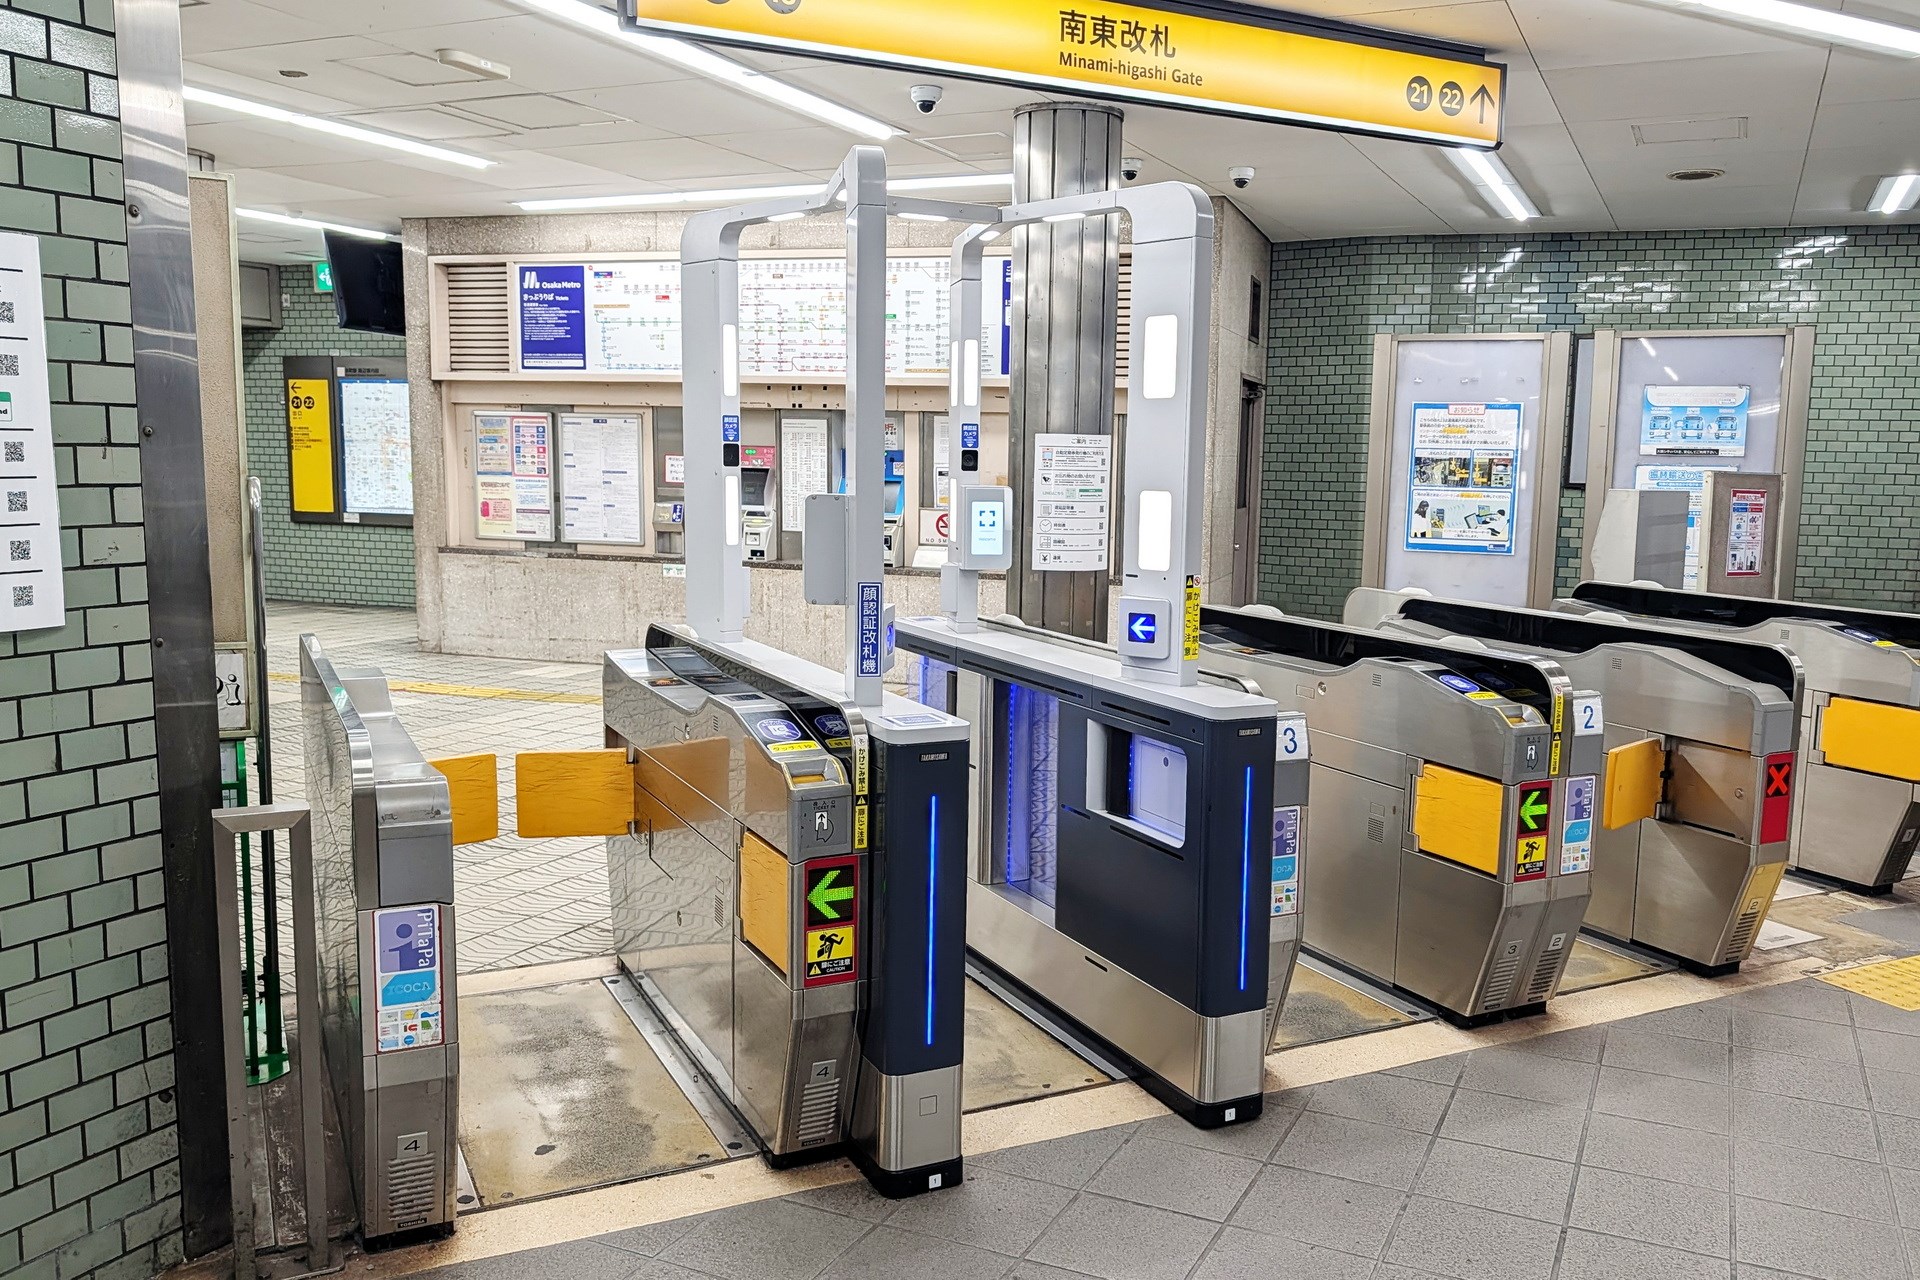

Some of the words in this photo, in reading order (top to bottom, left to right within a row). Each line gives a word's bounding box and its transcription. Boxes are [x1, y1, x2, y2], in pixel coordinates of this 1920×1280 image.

[1059, 10, 1176, 58] 南東改札
[1059, 51, 1167, 81] Minami-higashi
[1171, 68, 1203, 86] Gate
[1410, 82, 1428, 104] 21
[1441, 87, 1461, 109] 22
[541, 281, 561, 289] Osaka
[561, 281, 581, 289] Metro
[293, 398, 301, 407] 21
[304, 398, 314, 407] 22
[1453, 406, 1480, 414] お知らせ
[862, 586, 878, 673] 顔認証改札機
[1190, 592, 1200, 656] かけこみ禁止
[1583, 705, 1595, 729] 2
[1283, 727, 1298, 754] 3
[858, 748, 867, 793] かけこみ禁止
[1582, 780, 1593, 818] PiTaPa
[857, 808, 866, 846] 扉にご注意
[1286, 811, 1298, 854] PiTaPa
[417, 910, 434, 967] PiTaPa
[1508, 945, 1518, 955] 3
[1552, 937, 1562, 947] 2
[821, 958, 851, 968] 扉にご注意
[388, 981, 431, 996] ICOCA
[816, 1066, 829, 1078] 4
[403, 1139, 421, 1152] 4
[400, 1219, 425, 1228] TOSHIBA
